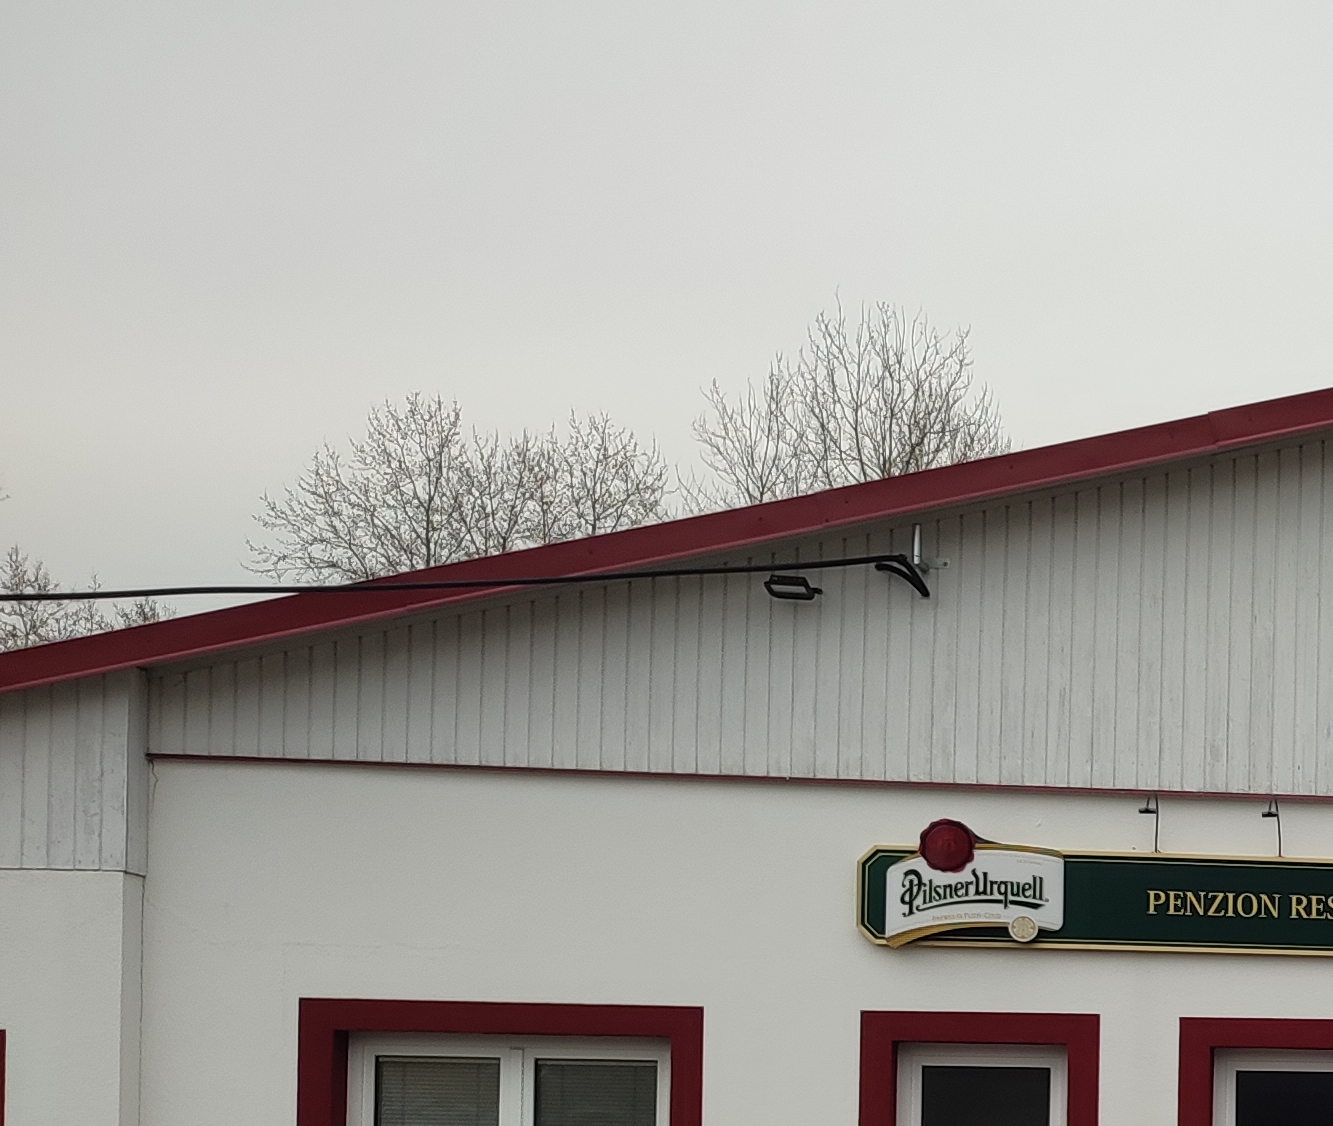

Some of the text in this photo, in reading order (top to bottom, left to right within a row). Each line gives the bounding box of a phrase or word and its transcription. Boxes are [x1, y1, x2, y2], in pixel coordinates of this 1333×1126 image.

[901, 868, 1044, 917] Pilsner Urquell
[1146, 890, 1282, 919] PENZION
